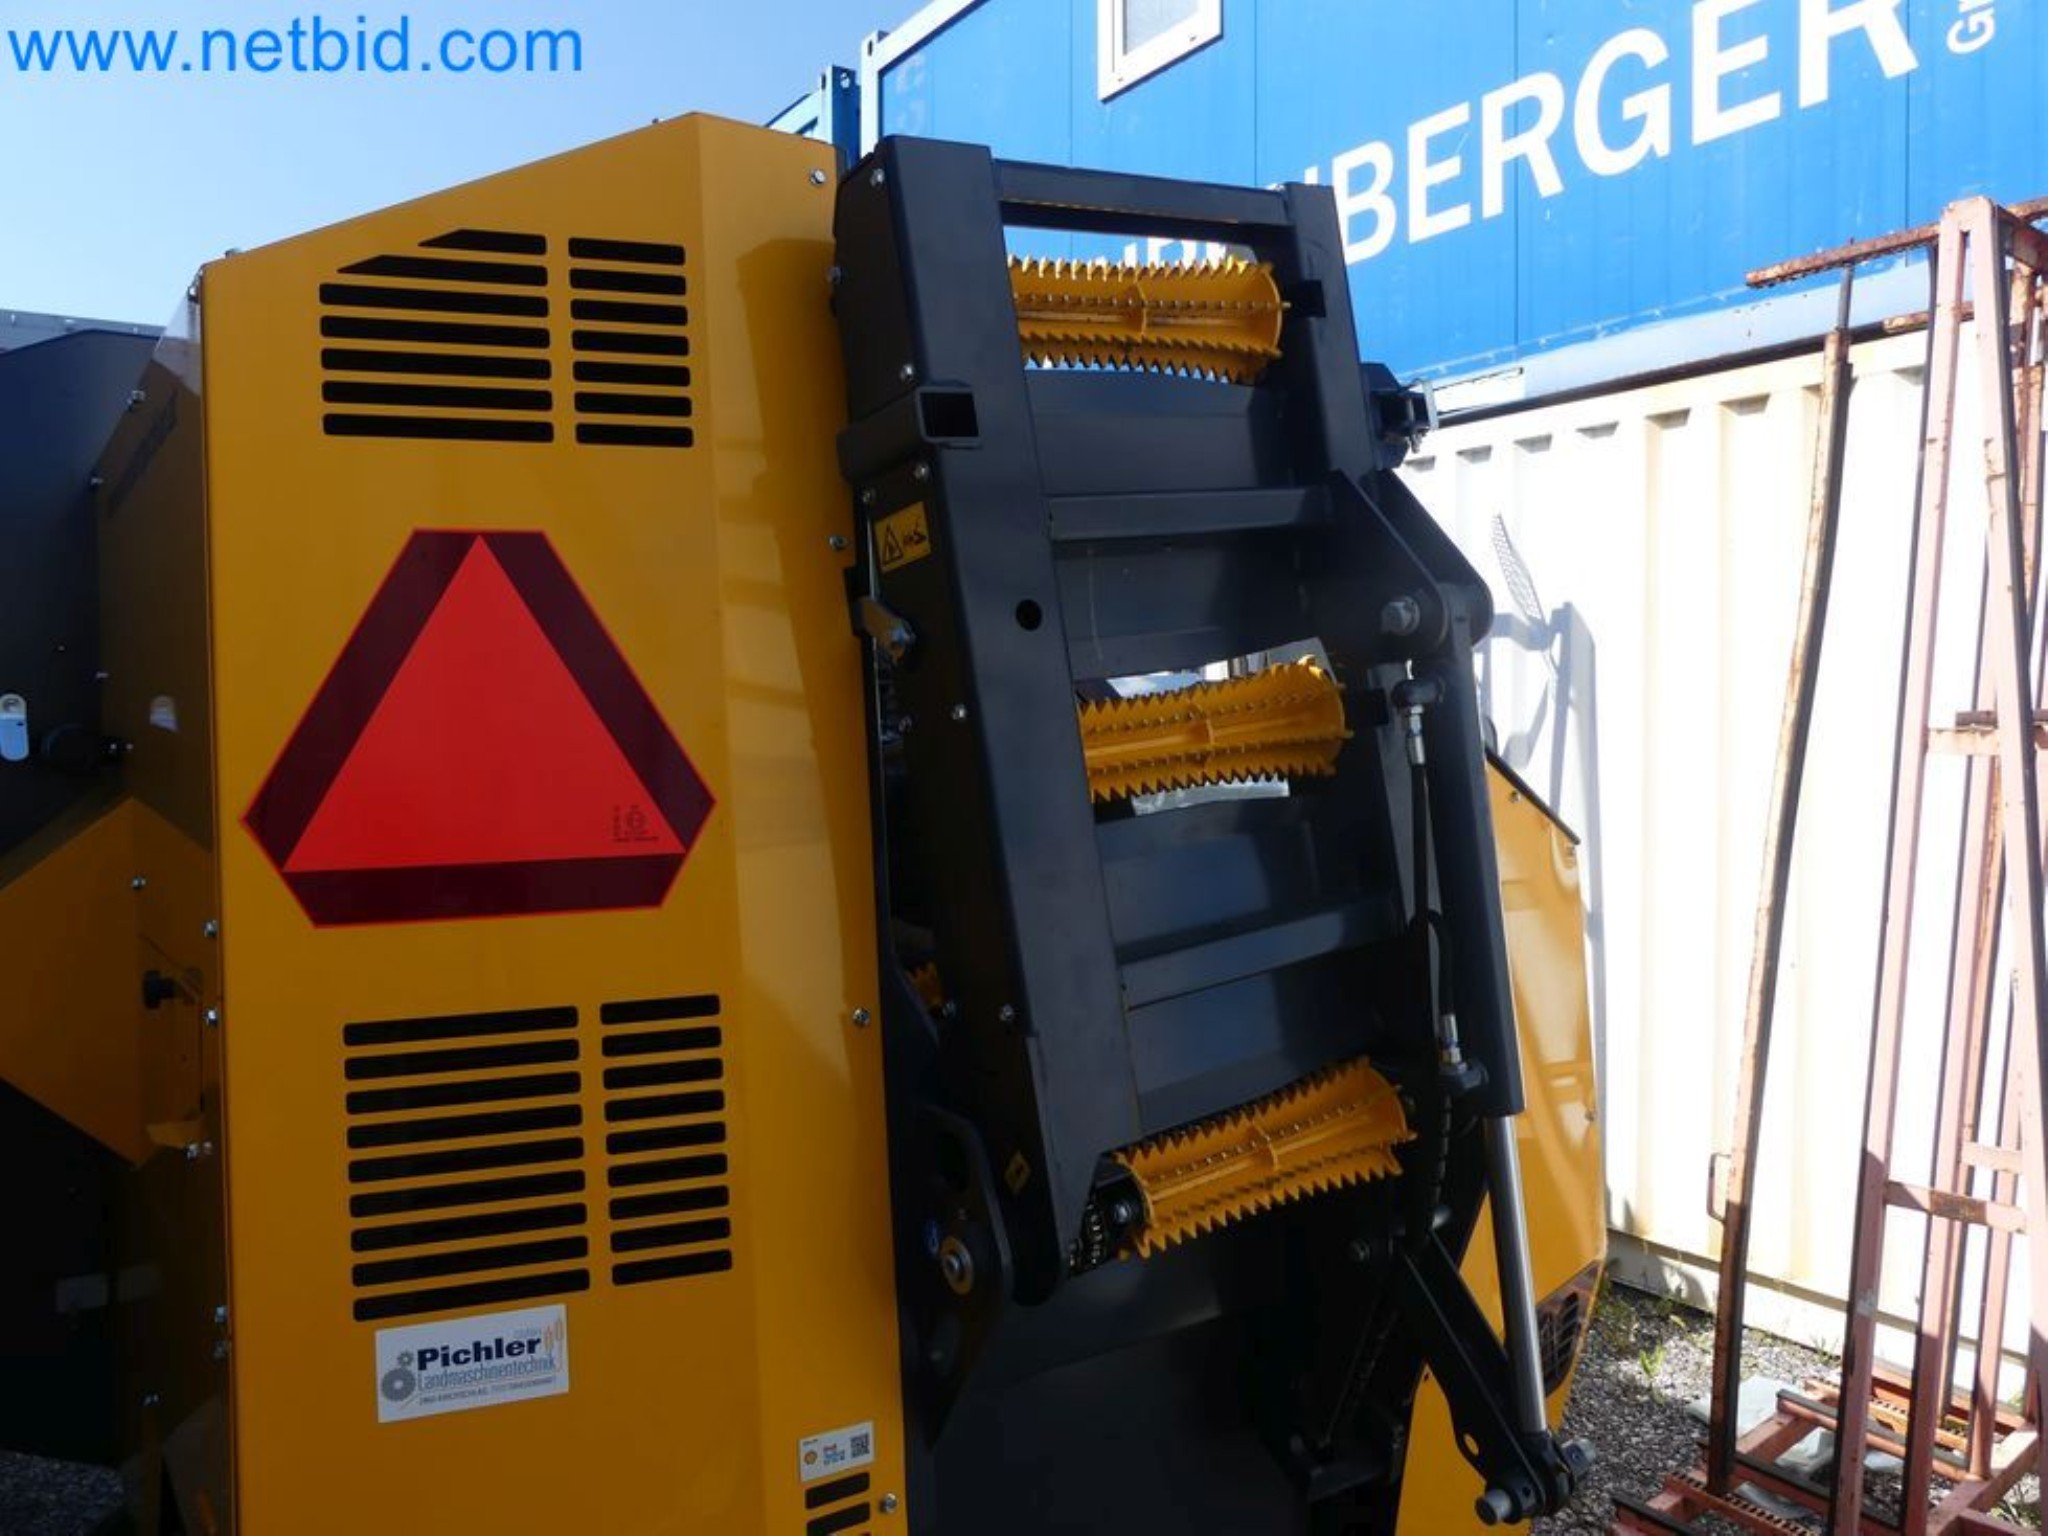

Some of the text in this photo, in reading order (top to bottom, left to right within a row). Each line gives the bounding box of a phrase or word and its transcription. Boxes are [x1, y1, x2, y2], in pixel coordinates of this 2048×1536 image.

[1304, 0, 1918, 266] BERGER
[417, 1337, 541, 1371] Pichler
[418, 1353, 555, 1391] Landmaschinentechnik
